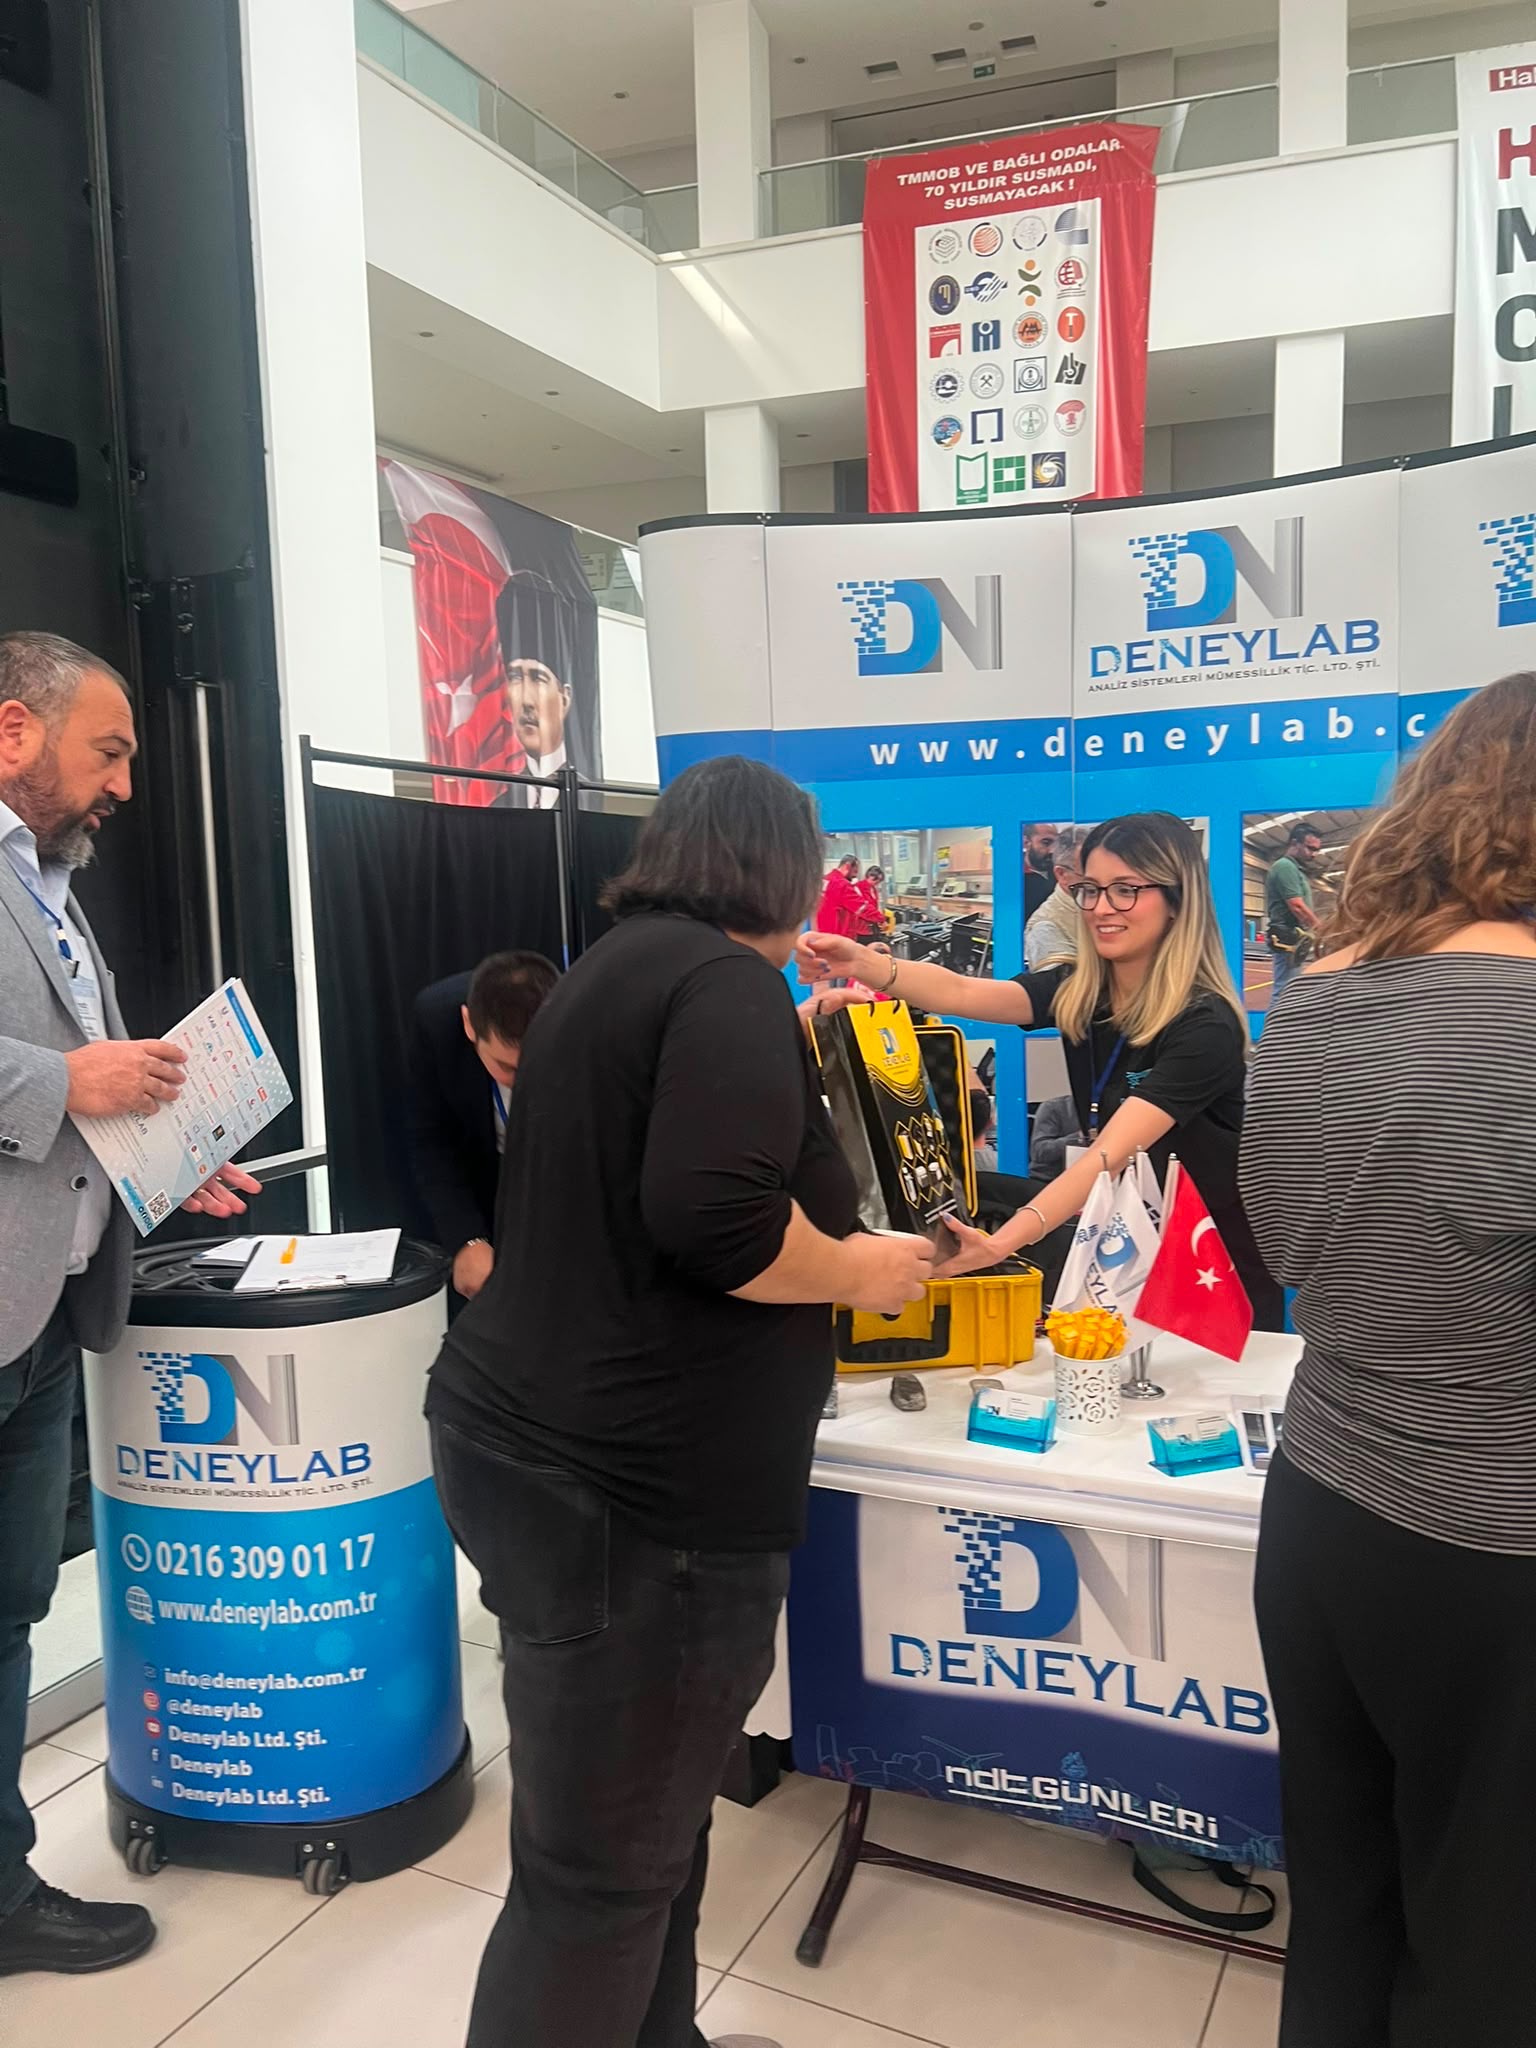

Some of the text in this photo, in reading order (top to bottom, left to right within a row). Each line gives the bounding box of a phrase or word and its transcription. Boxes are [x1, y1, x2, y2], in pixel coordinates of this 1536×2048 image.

[897, 138, 1125, 186] TMMOB VE BAĞLI ODALAR
[924, 186, 944, 198] 70
[949, 176, 1007, 194] YILDIR
[944, 180, 1064, 210] SUSMAYACAK
[1089, 619, 1381, 678] DENEYLAB
[1088, 680, 1128, 693] ANALİZ
[1131, 673, 1203, 688] SİSTEMLERİ
[1323, 661, 1352, 672] LTD.
[1356, 658, 1381, 671] ŞTİ.
[116, 1442, 372, 1484] DENEYLAB
[321, 1483, 347, 1494] LTD.
[155, 1533, 375, 1579] 0216 309 01 17
[158, 1591, 377, 1631] www.deneylab.com.tr
[164, 1666, 367, 1694] info@deneylab.com.tr
[889, 1633, 1271, 1736] DENEYLAB
[167, 1699, 263, 1721] @deneylab
[168, 1725, 328, 1750] Deneylab Ltd. Şti.
[170, 1754, 253, 1778] Deneylab
[172, 1782, 254, 1807] Deneylab
[257, 1788, 294, 1805] Ltd.
[297, 1786, 331, 1808] Şti.
